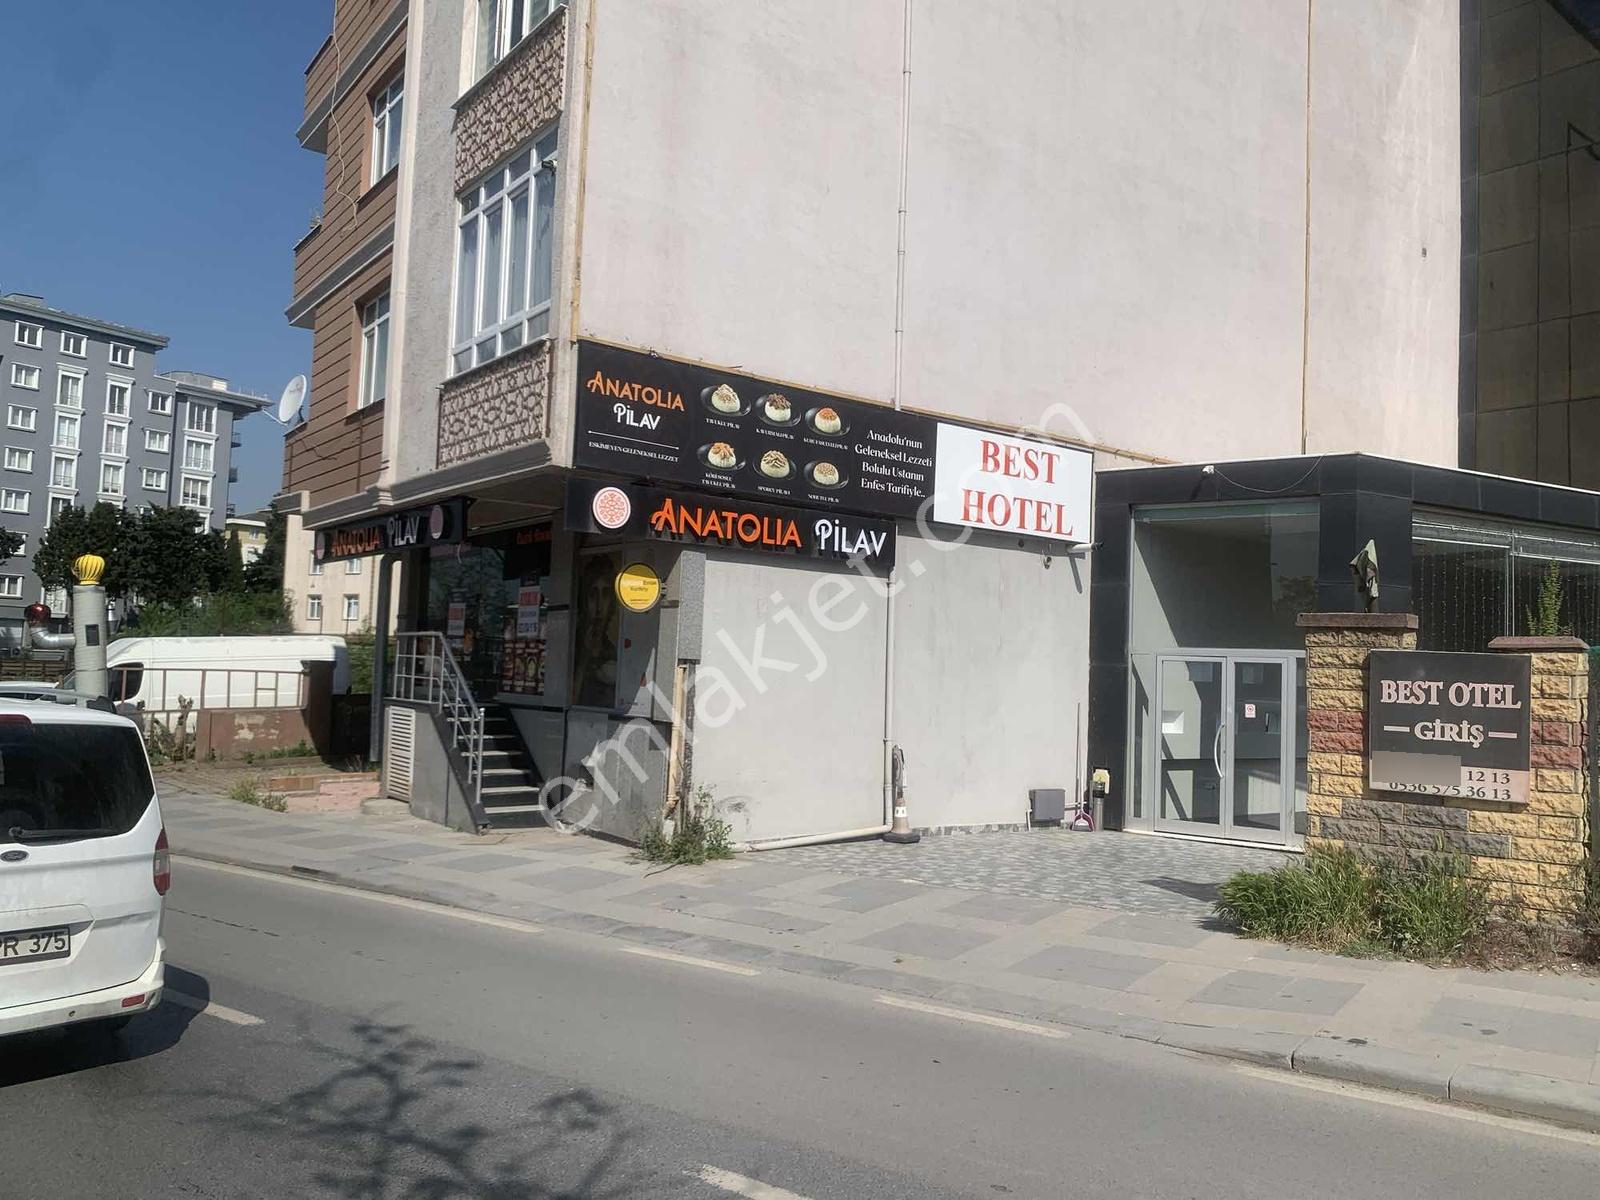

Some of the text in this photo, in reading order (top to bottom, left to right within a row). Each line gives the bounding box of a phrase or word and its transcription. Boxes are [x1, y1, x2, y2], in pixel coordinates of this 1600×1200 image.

[587, 371, 684, 411] ANATOLIA
[613, 403, 660, 430] PİLAV
[866, 429, 923, 449] Anadolu'nun
[854, 443, 933, 467] Geleneksel Lezzeti
[980, 439, 1060, 484] BEST
[862, 461, 891, 476] Bolulu
[861, 477, 886, 491] Enfes
[960, 488, 1073, 537] HOTEL
[651, 498, 888, 557] ANATOLIA PİLAV
[1380, 680, 1522, 709] BEST OTEL
[1414, 718, 1485, 749] GİRİŞ
[1467, 770, 1511, 785] 12 13
[1466, 786, 1486, 798] 36
[1493, 789, 1512, 801] 13
[29, 931, 66, 953] 375
